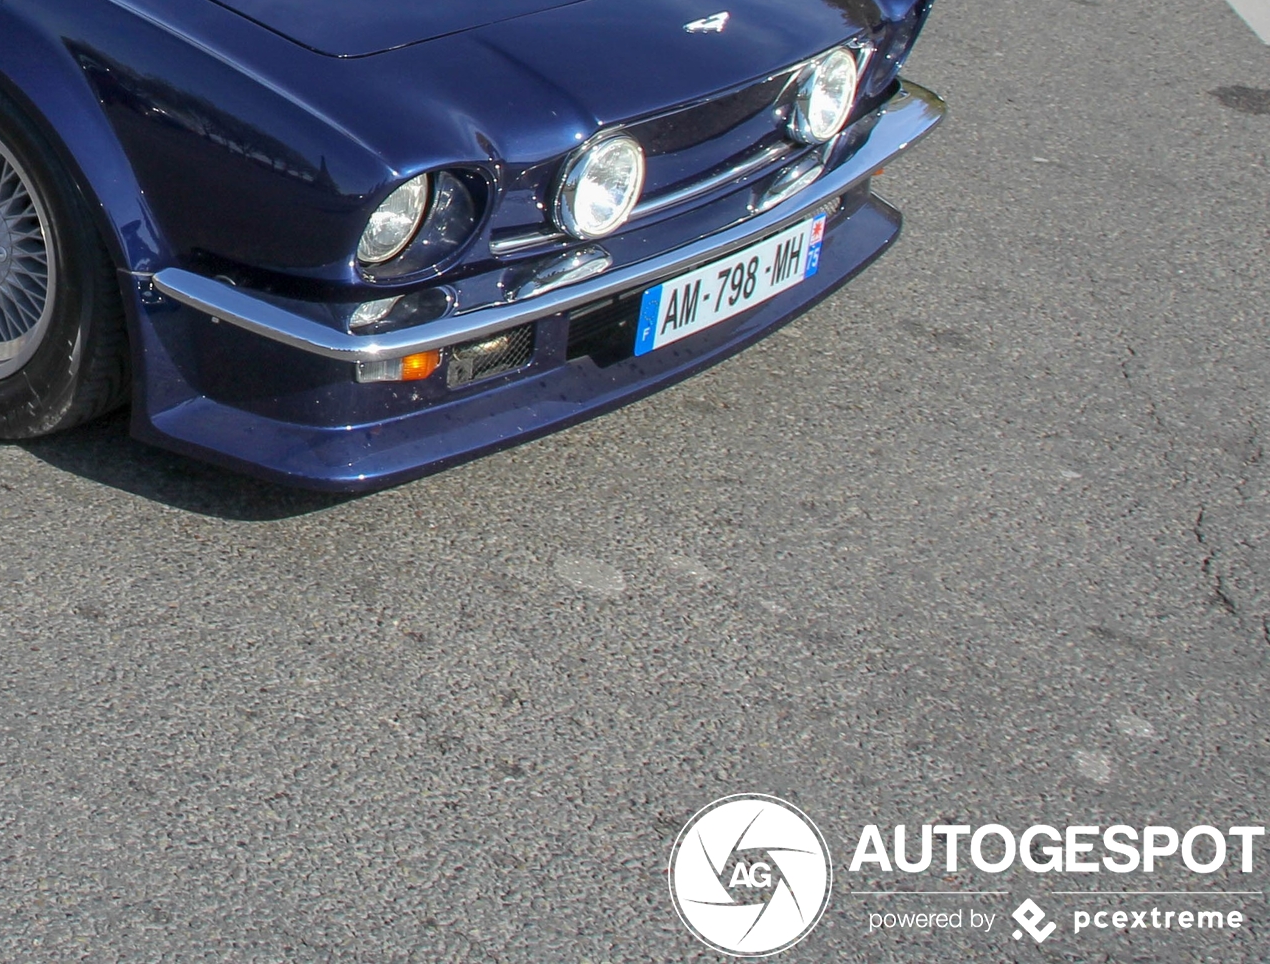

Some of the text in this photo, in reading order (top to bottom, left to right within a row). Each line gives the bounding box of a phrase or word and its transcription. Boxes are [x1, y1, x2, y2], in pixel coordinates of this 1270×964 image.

[806, 247, 821, 270] 75
[660, 233, 804, 336] AM-798-MH
[641, 327, 650, 341] F
